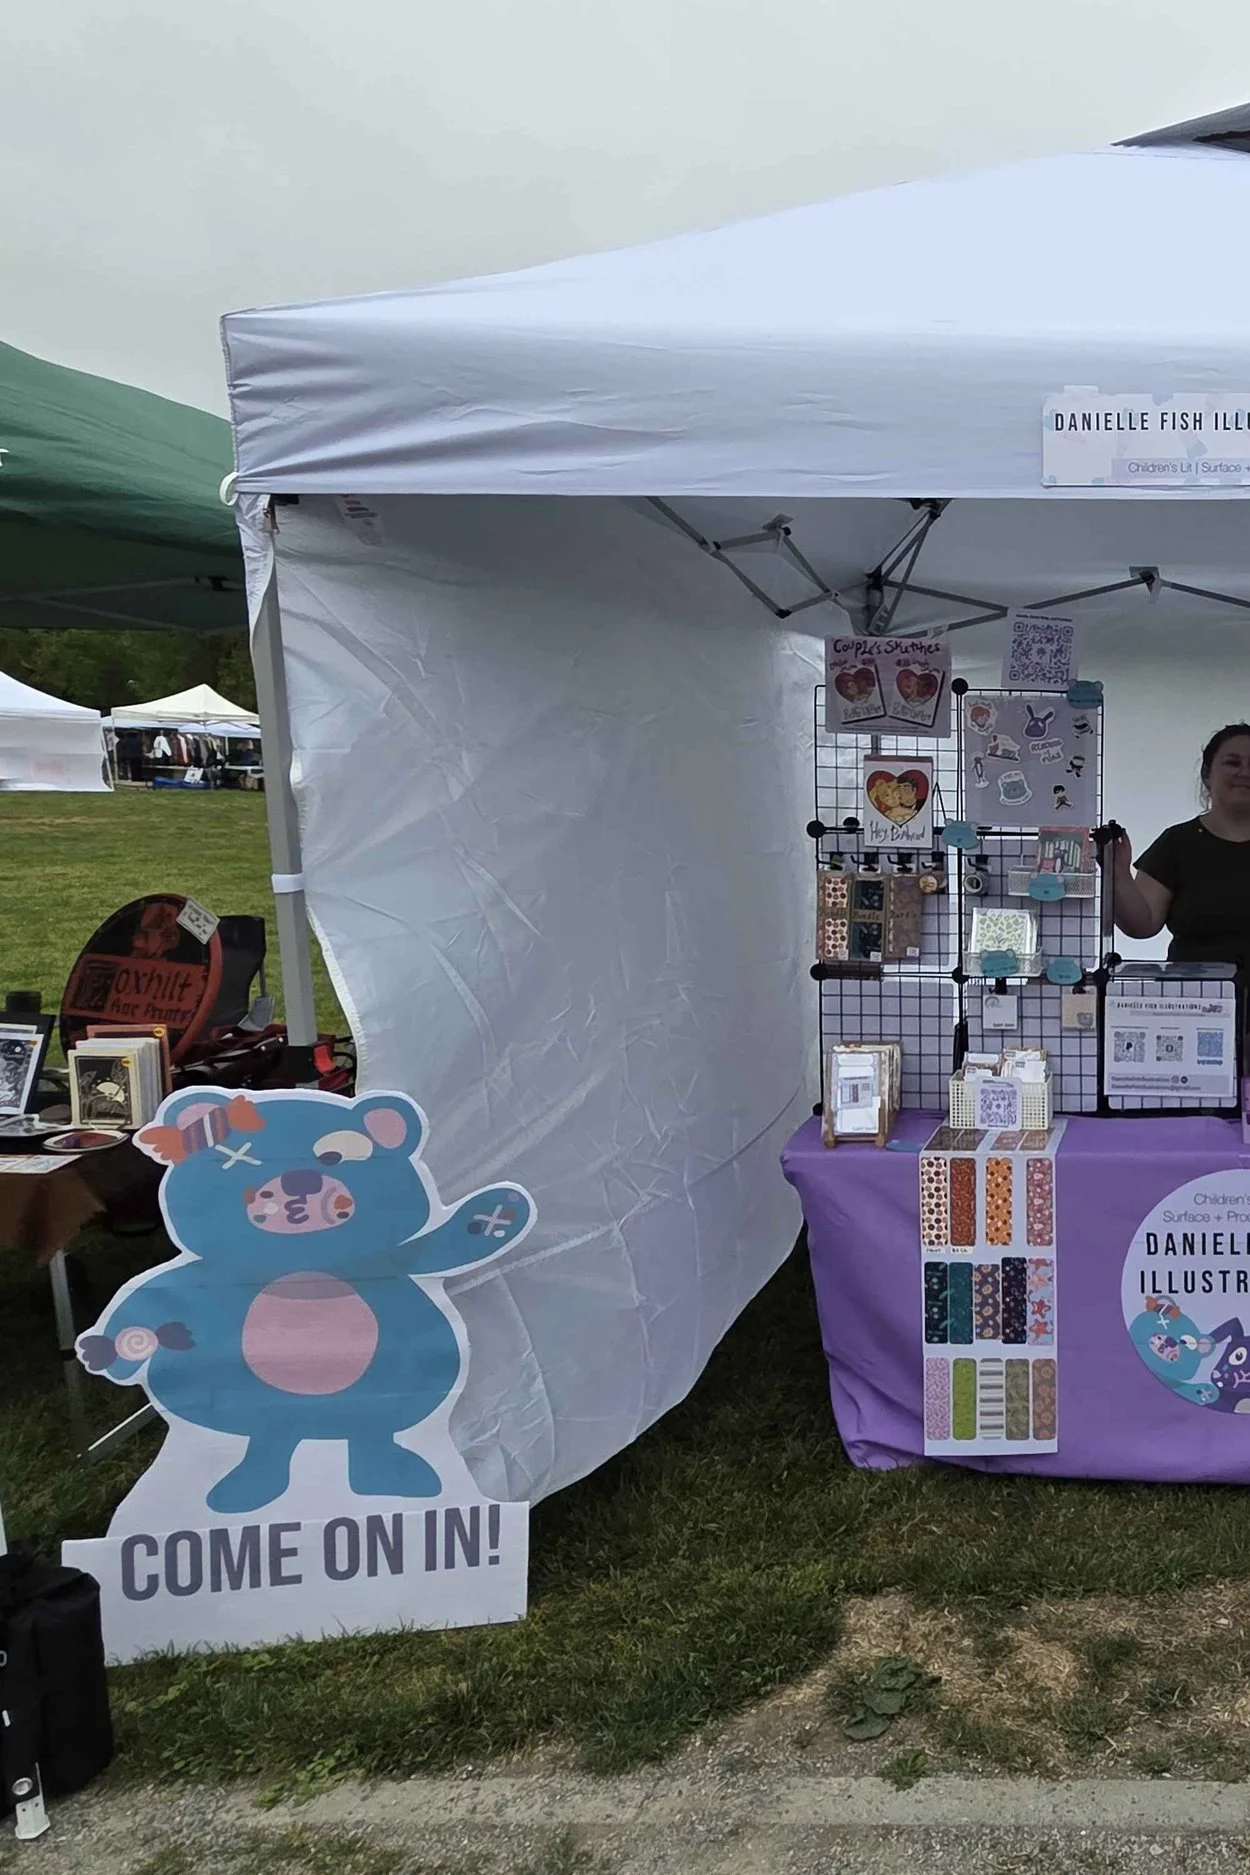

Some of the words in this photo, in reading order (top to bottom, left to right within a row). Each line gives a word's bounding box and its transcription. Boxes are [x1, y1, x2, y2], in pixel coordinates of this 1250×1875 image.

[1055, 411, 1149, 432] DANIELLE
[1160, 411, 1203, 431] FISH
[1127, 460, 1179, 474] Children's
[1180, 460, 1193, 474] Lit
[1201, 460, 1242, 474] Surface
[1162, 1210, 1211, 1224] Surface
[120, 1520, 302, 1602] COME
[322, 1511, 404, 1582] ON
[424, 1502, 501, 1573] IN!
